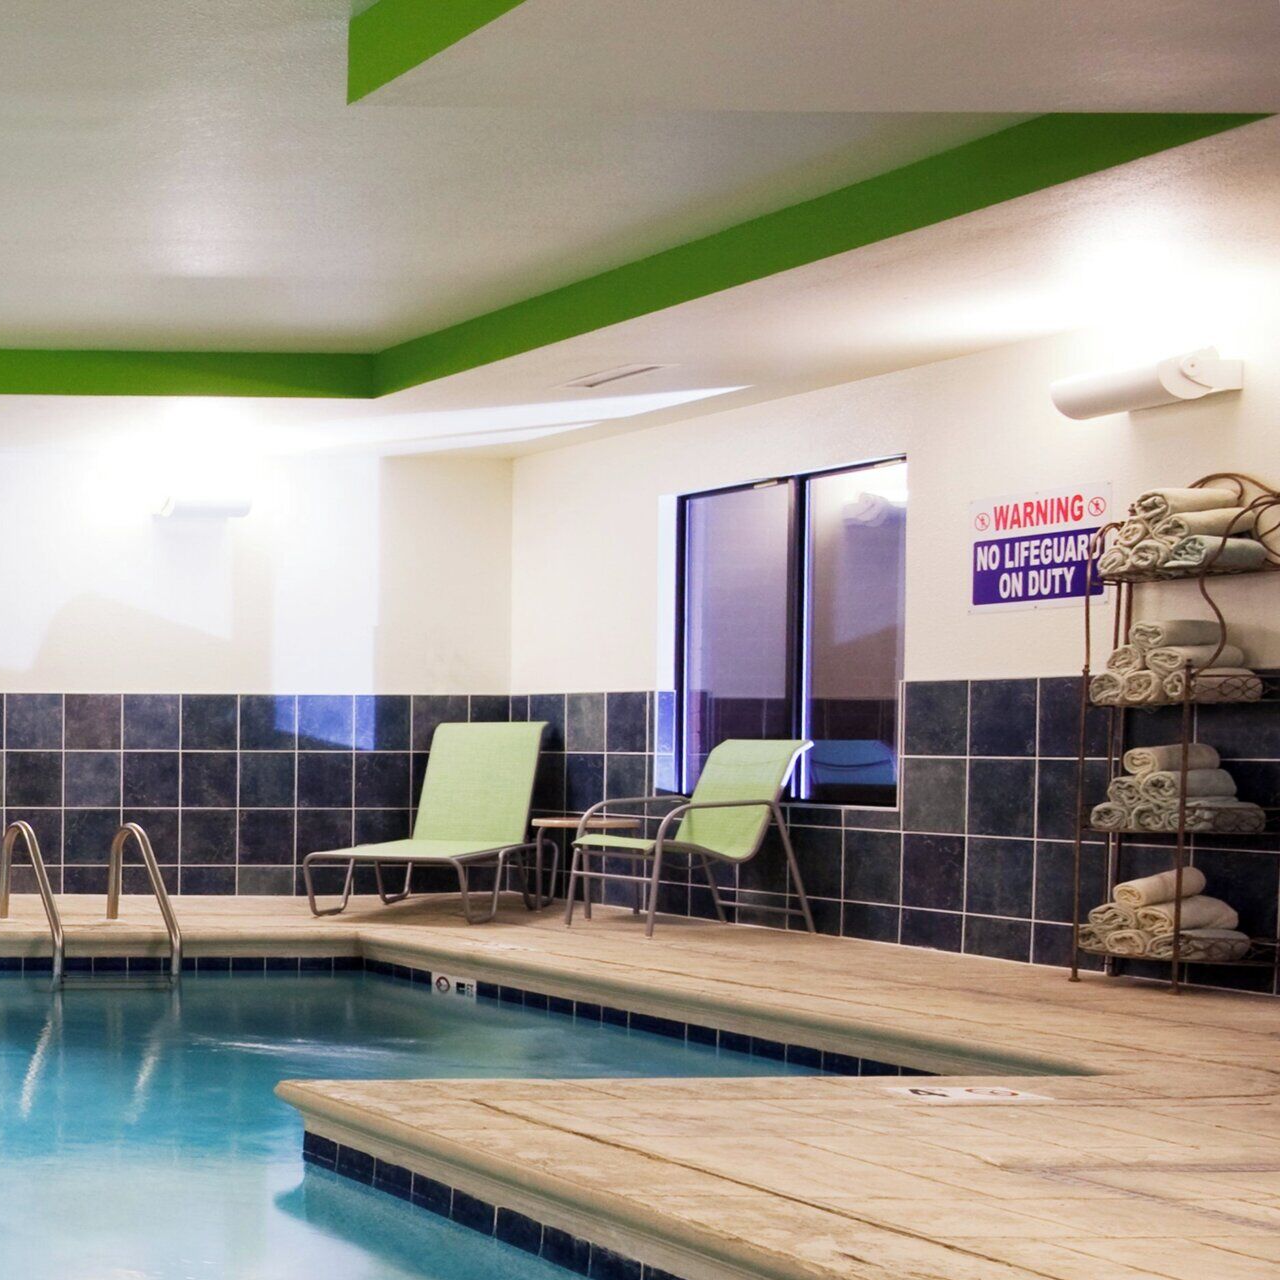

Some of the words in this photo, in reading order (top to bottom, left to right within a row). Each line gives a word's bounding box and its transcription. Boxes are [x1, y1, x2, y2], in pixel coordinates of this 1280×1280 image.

[993, 494, 1084, 531] WARNING
[976, 544, 1000, 572] NO
[999, 572, 1023, 599] ON
[1027, 566, 1076, 597] DUTY
